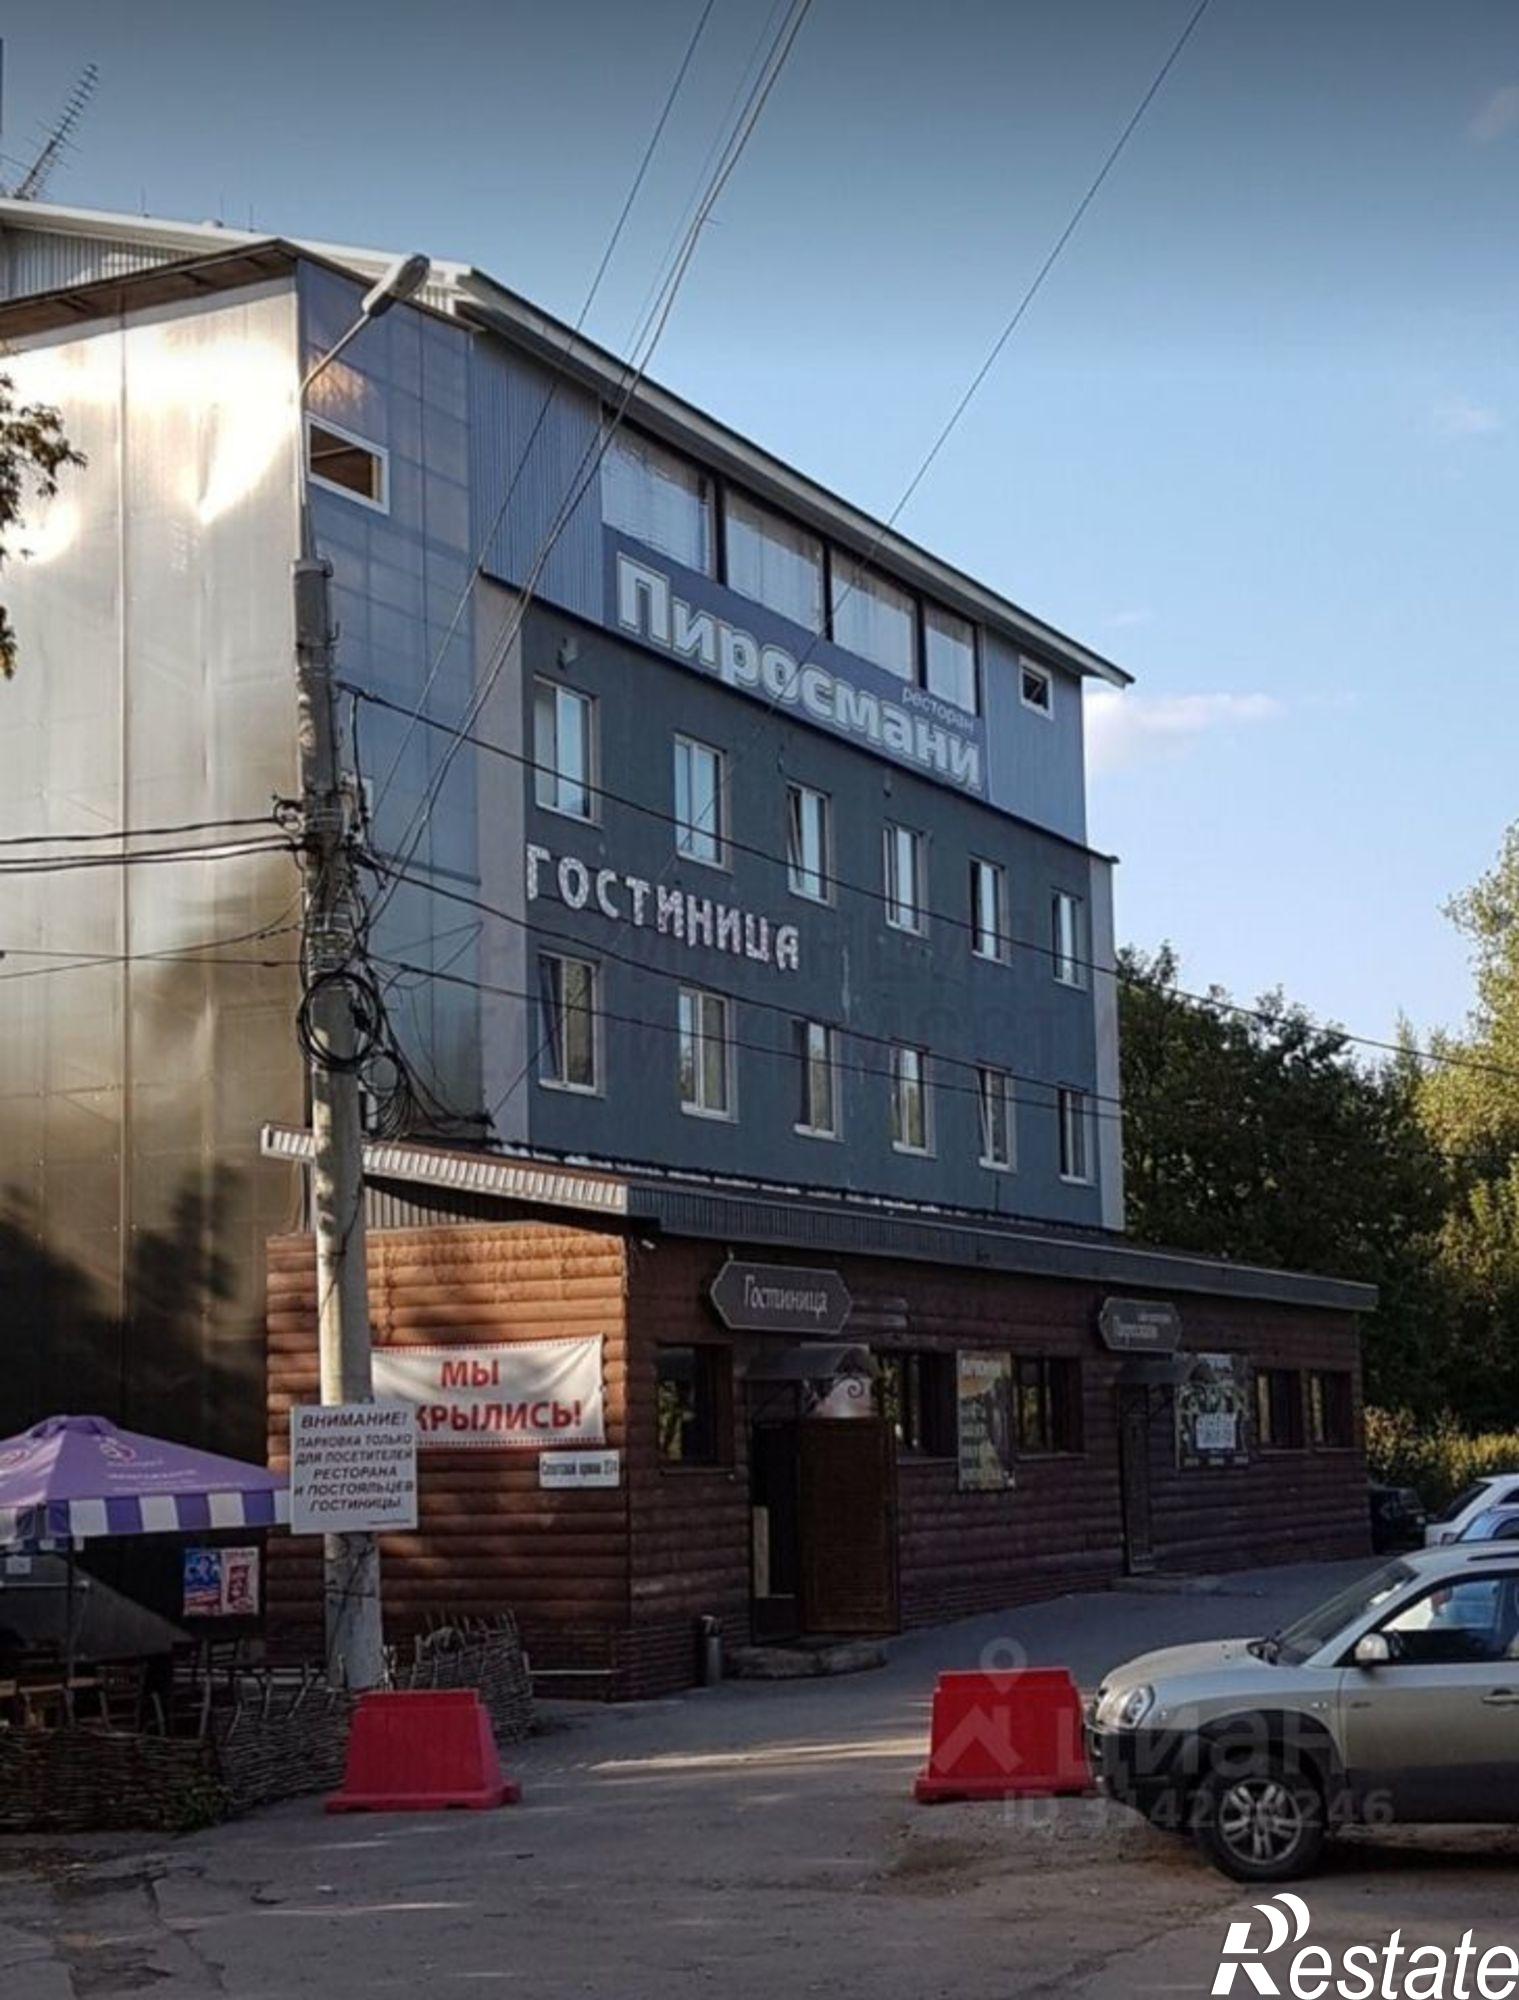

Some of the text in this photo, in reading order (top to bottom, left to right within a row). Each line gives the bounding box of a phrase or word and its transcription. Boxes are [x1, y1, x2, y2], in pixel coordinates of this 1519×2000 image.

[616, 551, 984, 793] Пиросмани
[902, 687, 975, 731] ресторан
[526, 844, 799, 971] ГОСТИНИЦА
[743, 1274, 828, 1321] Гостиница
[441, 1361, 500, 1388] МЫ
[301, 1412, 407, 1429] ВНИМАНИЕ!
[415, 1401, 582, 1431] КРЫЛИСЬ!
[296, 1433, 413, 1448] ПАРКОВКА ТОЛЬКО
[296, 1449, 413, 1466] ДЛЯ ПОСЕТИТЕЛЕЙ
[313, 1466, 398, 1480] РЕСТОРАНА
[307, 1481, 414, 1496] ПОСТОЯЛЬЦЕВ
[310, 1497, 401, 1512] ГОСТИНИЦЫ
